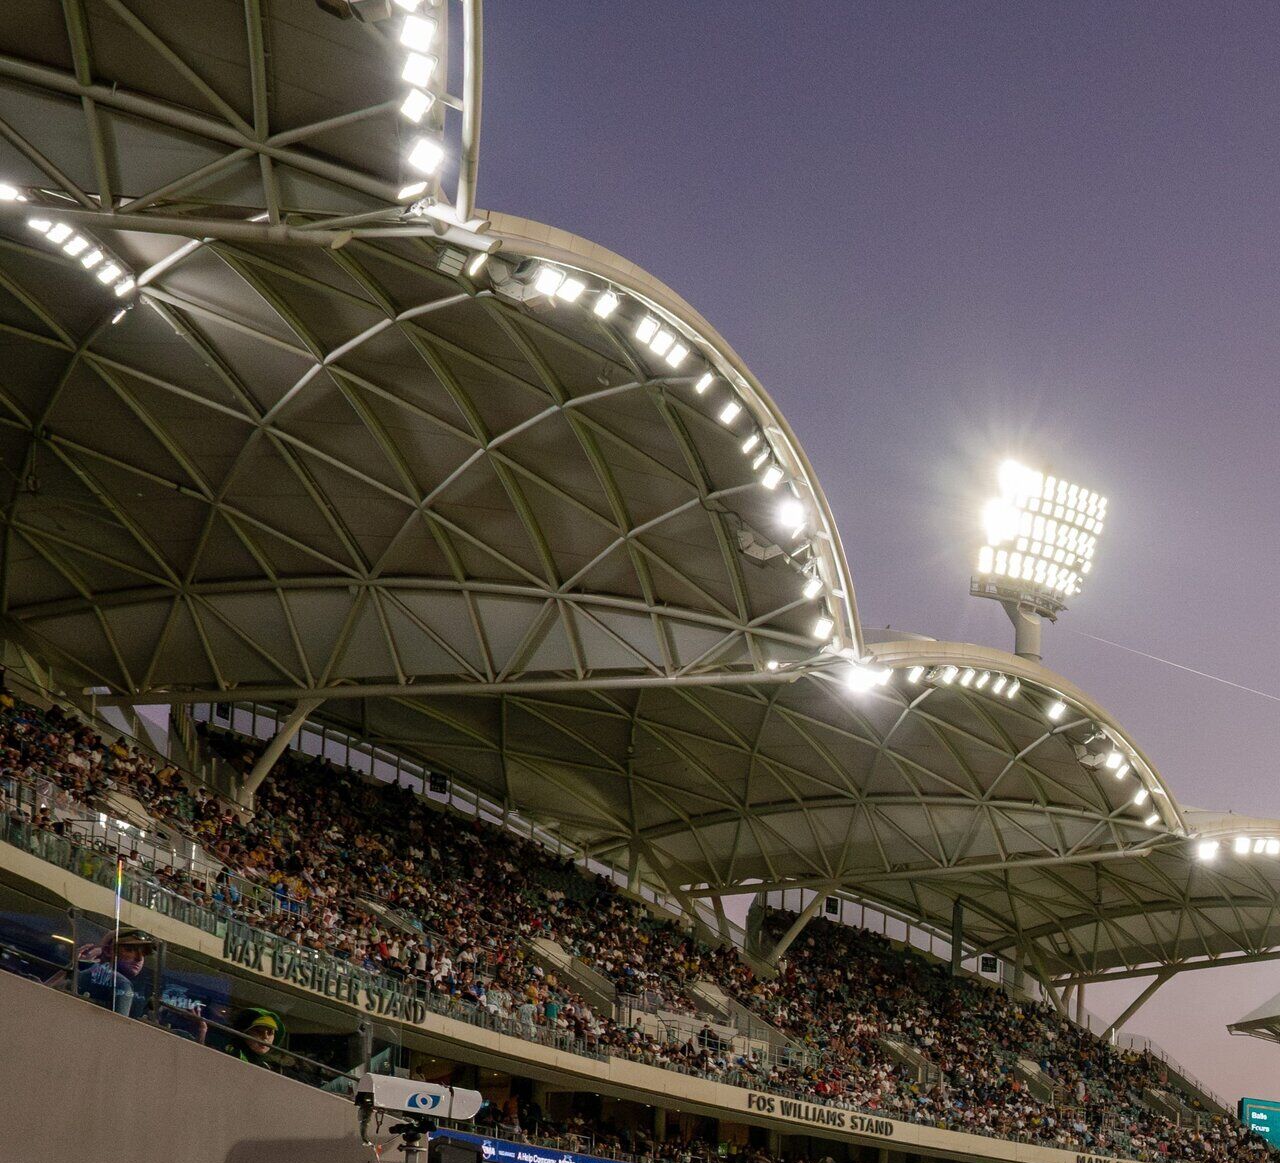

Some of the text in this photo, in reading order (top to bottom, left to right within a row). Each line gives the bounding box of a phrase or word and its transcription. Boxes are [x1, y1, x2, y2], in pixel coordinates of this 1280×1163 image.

[224, 924, 264, 972] MAX
[366, 980, 426, 1024] STAND
[748, 1093, 893, 1136] FOS WILLIAMS STAND
[1252, 1112, 1267, 1120] Balls
[1252, 1124, 1270, 1132] Fours
